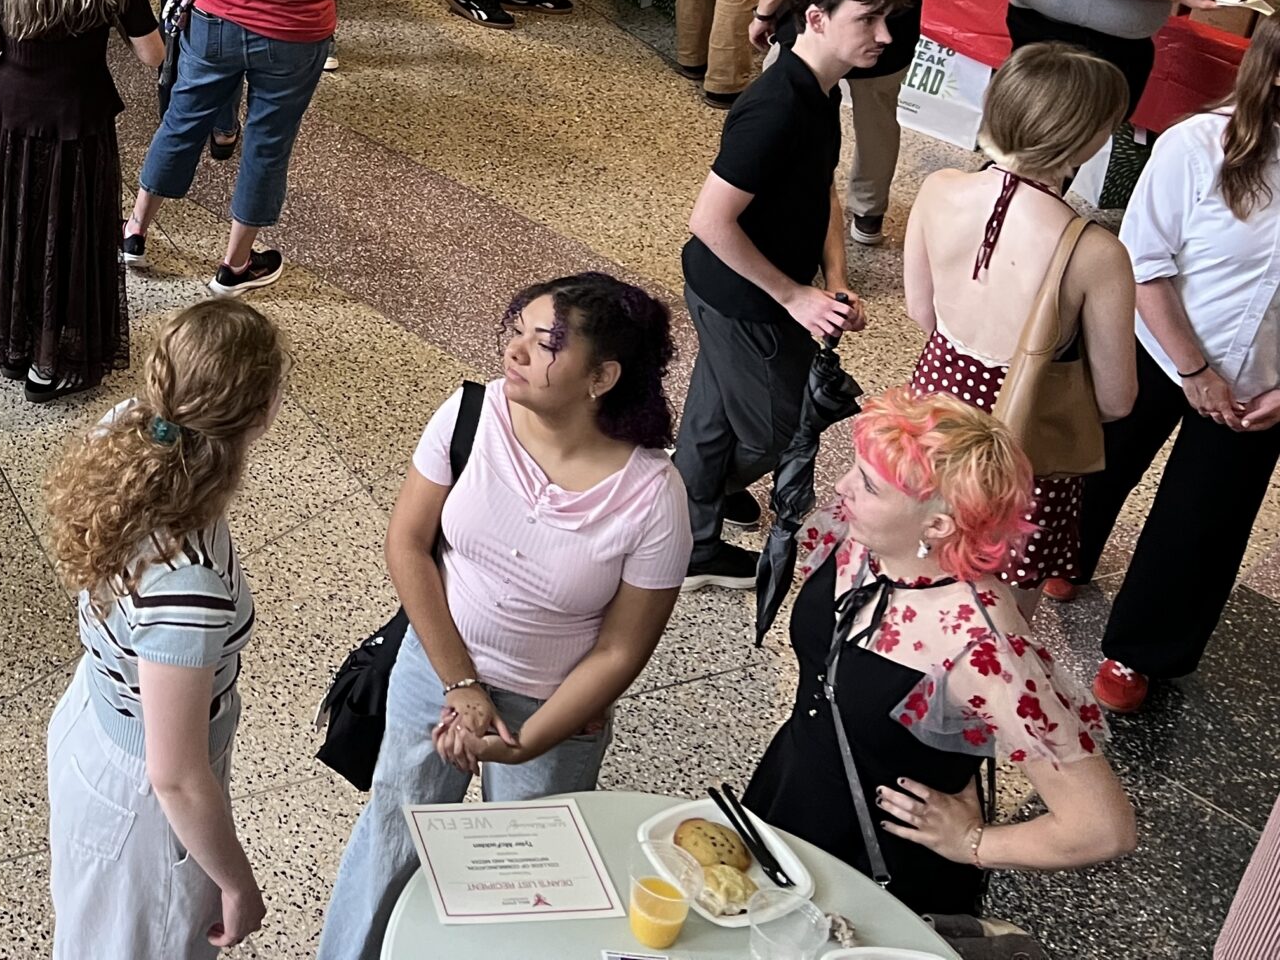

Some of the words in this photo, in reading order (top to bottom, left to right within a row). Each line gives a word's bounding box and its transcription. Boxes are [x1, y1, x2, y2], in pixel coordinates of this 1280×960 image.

[937, 44, 956, 57] TO
[426, 818, 458, 831] FLY
[460, 816, 493, 830] WE
[466, 881, 516, 892] RECIPIENT
[517, 880, 537, 890] LIST
[541, 878, 574, 888] DEAN'S
